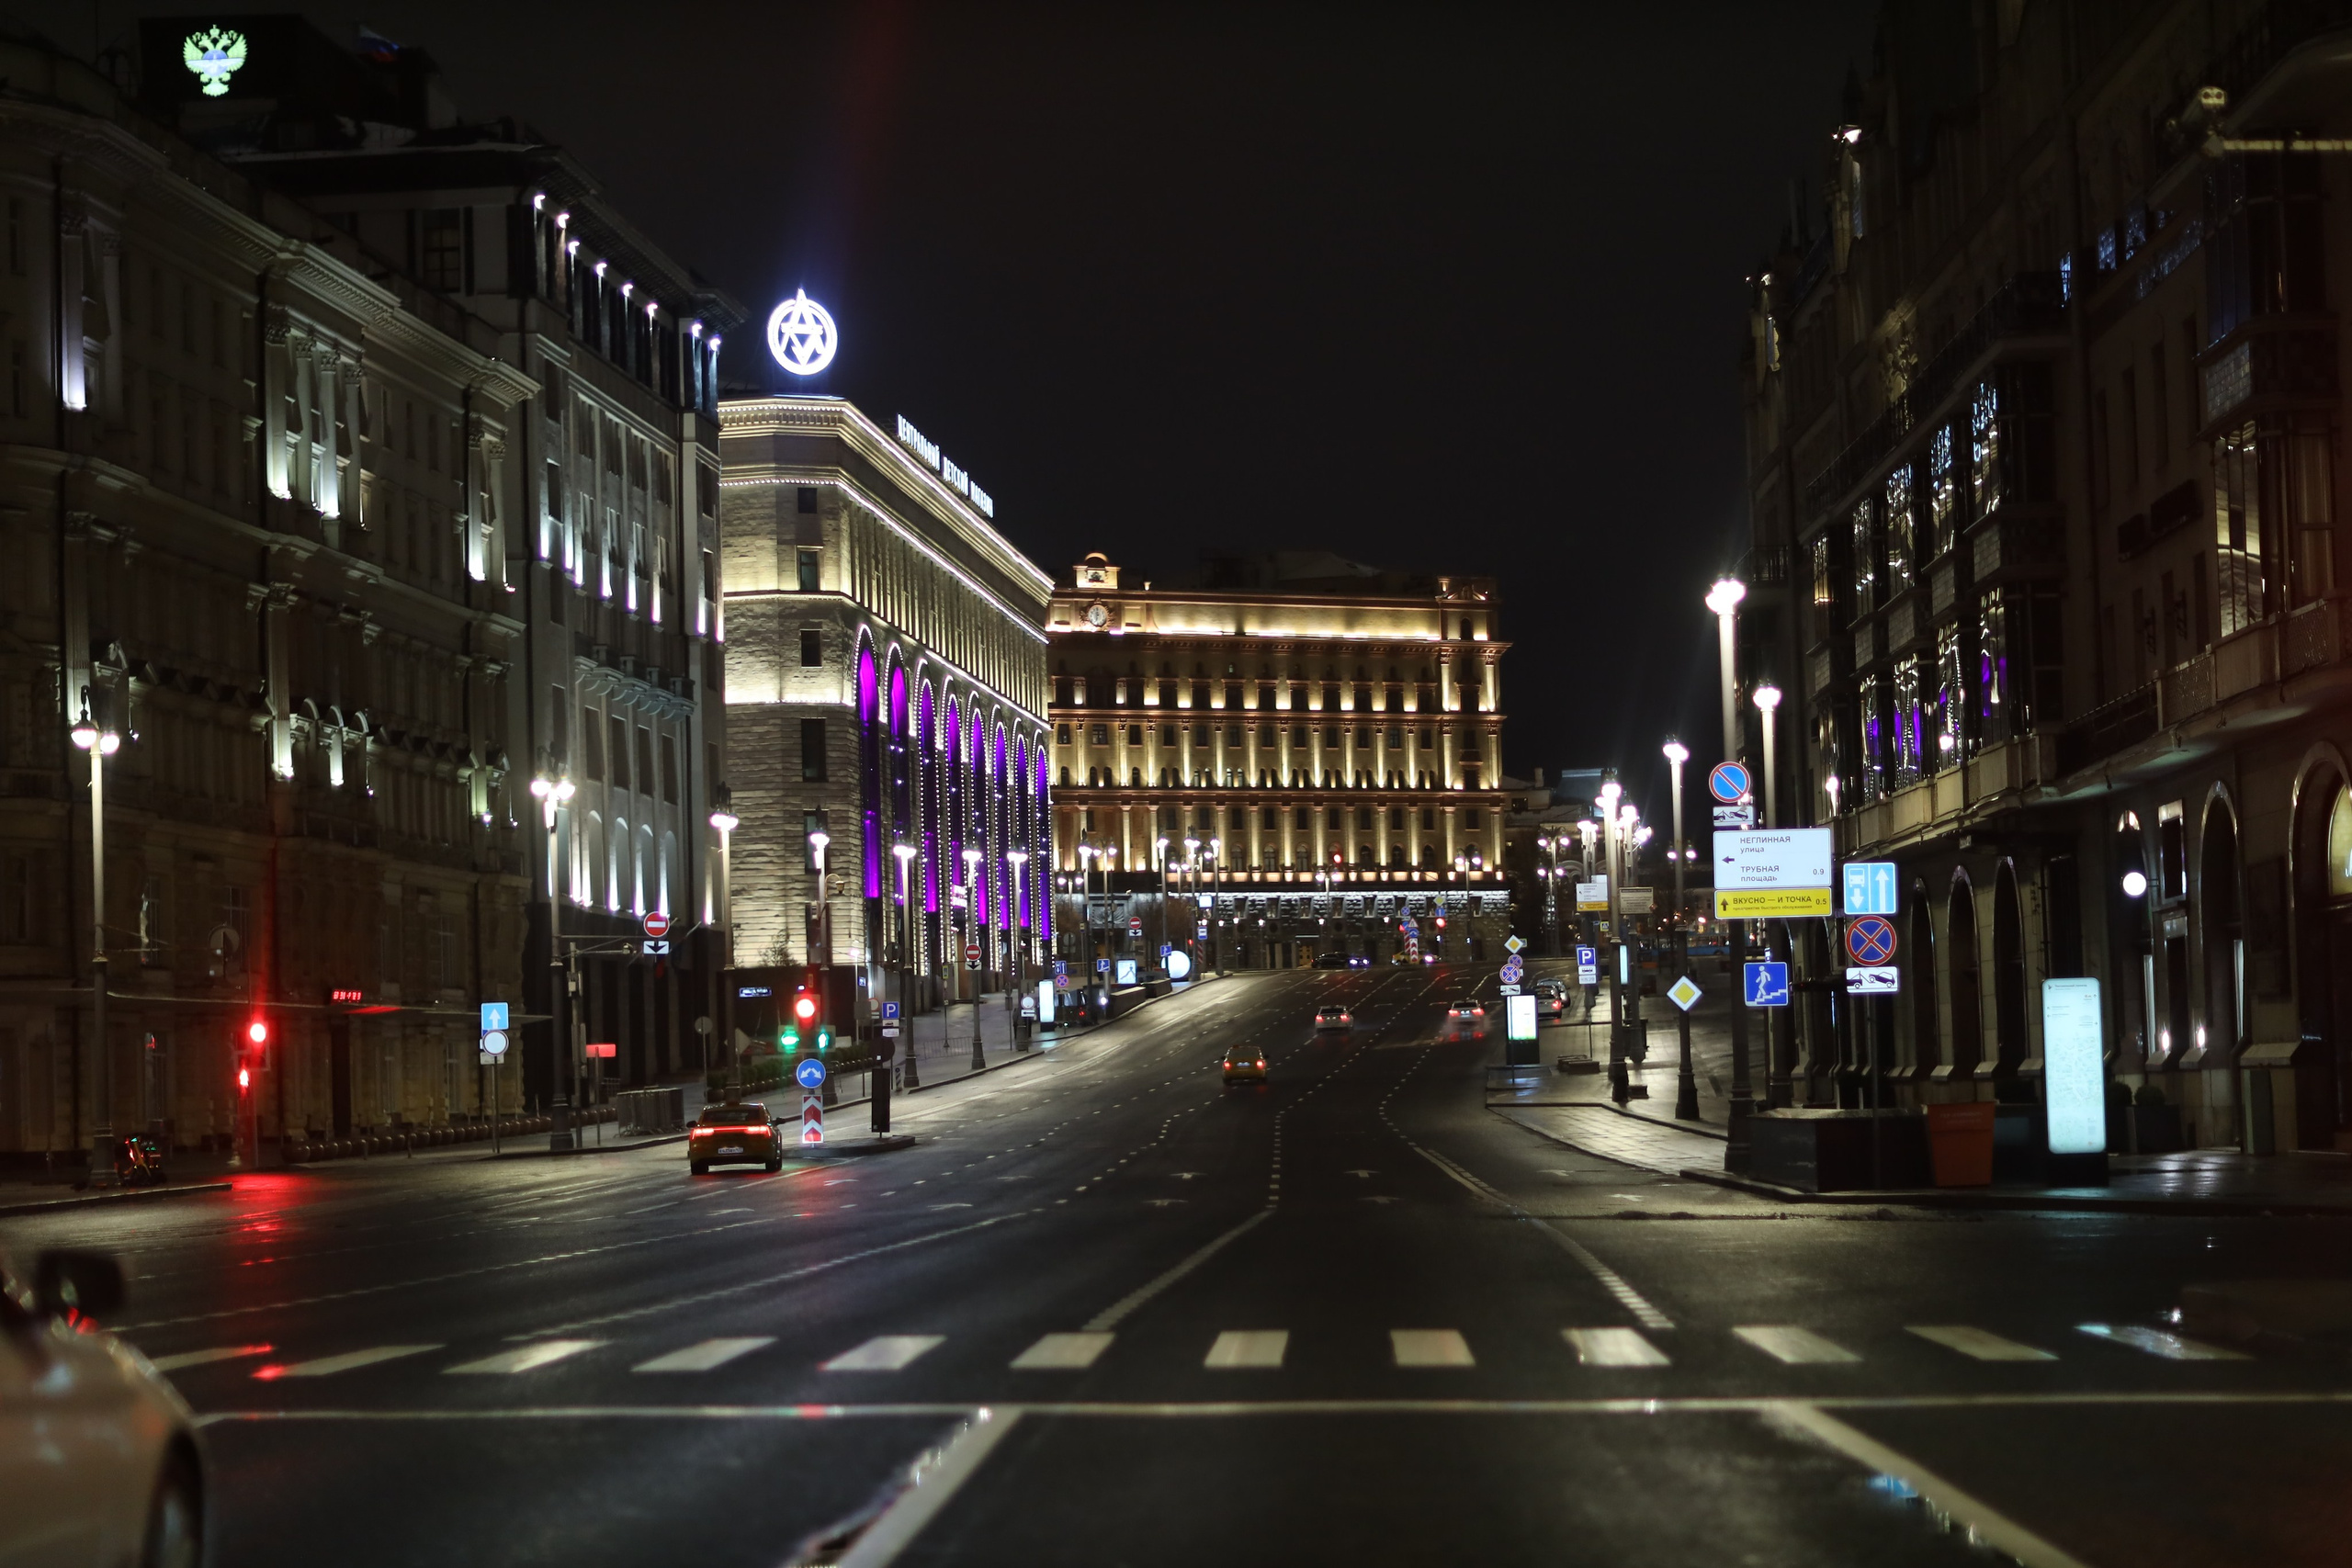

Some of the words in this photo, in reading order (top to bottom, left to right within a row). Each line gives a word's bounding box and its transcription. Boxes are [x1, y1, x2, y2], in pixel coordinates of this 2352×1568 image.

[1739, 836, 1791, 844] НЕГЛИННАЯ
[1740, 846, 1765, 854] улица
[1733, 897, 1766, 905] ВКУСНО
